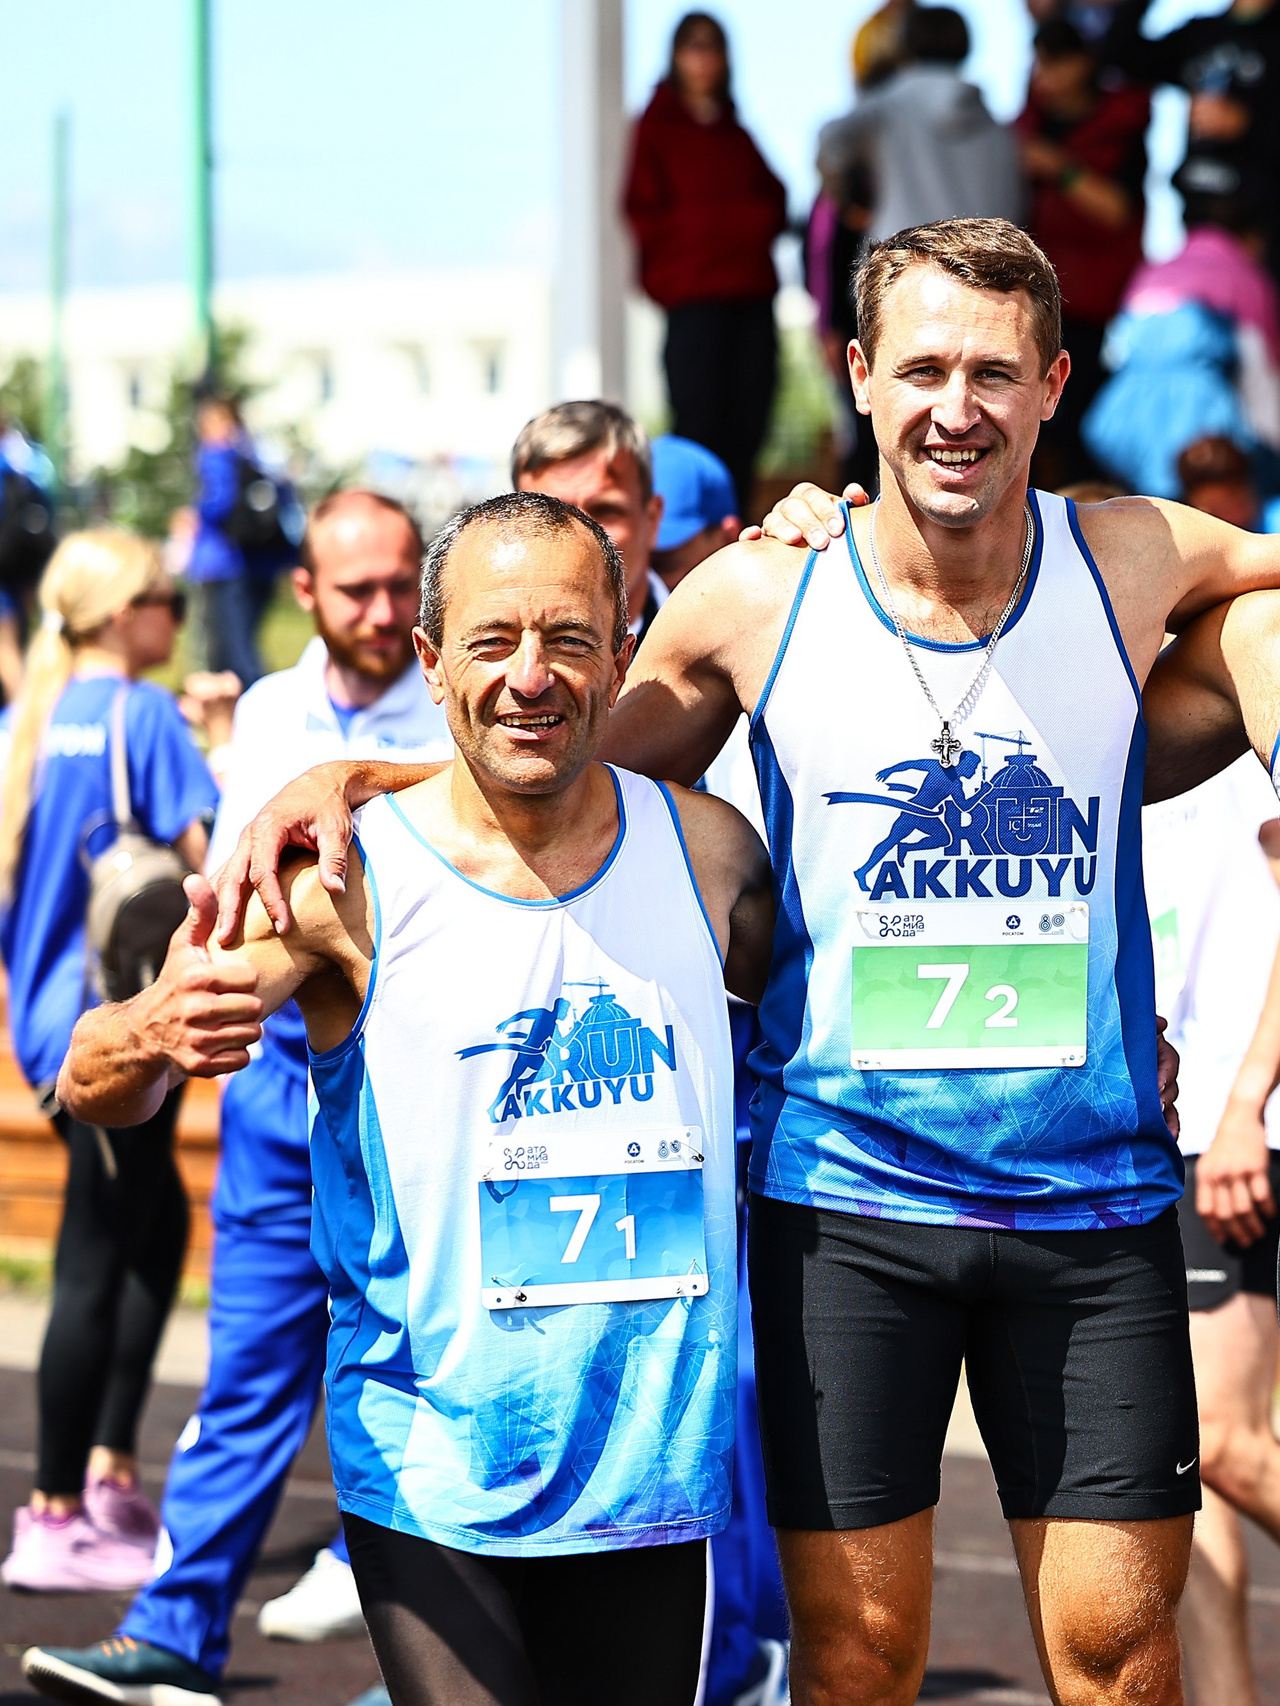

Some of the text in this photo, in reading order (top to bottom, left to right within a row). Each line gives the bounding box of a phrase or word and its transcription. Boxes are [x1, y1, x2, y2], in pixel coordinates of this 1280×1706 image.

[944, 796, 1100, 856] RUN
[868, 854, 1098, 900] AKKUYU
[917, 963, 1018, 1030] 7 2
[549, 1024, 677, 1085] RUN
[501, 1075, 654, 1123] AKKUYU
[549, 1194, 636, 1264] 7 1
